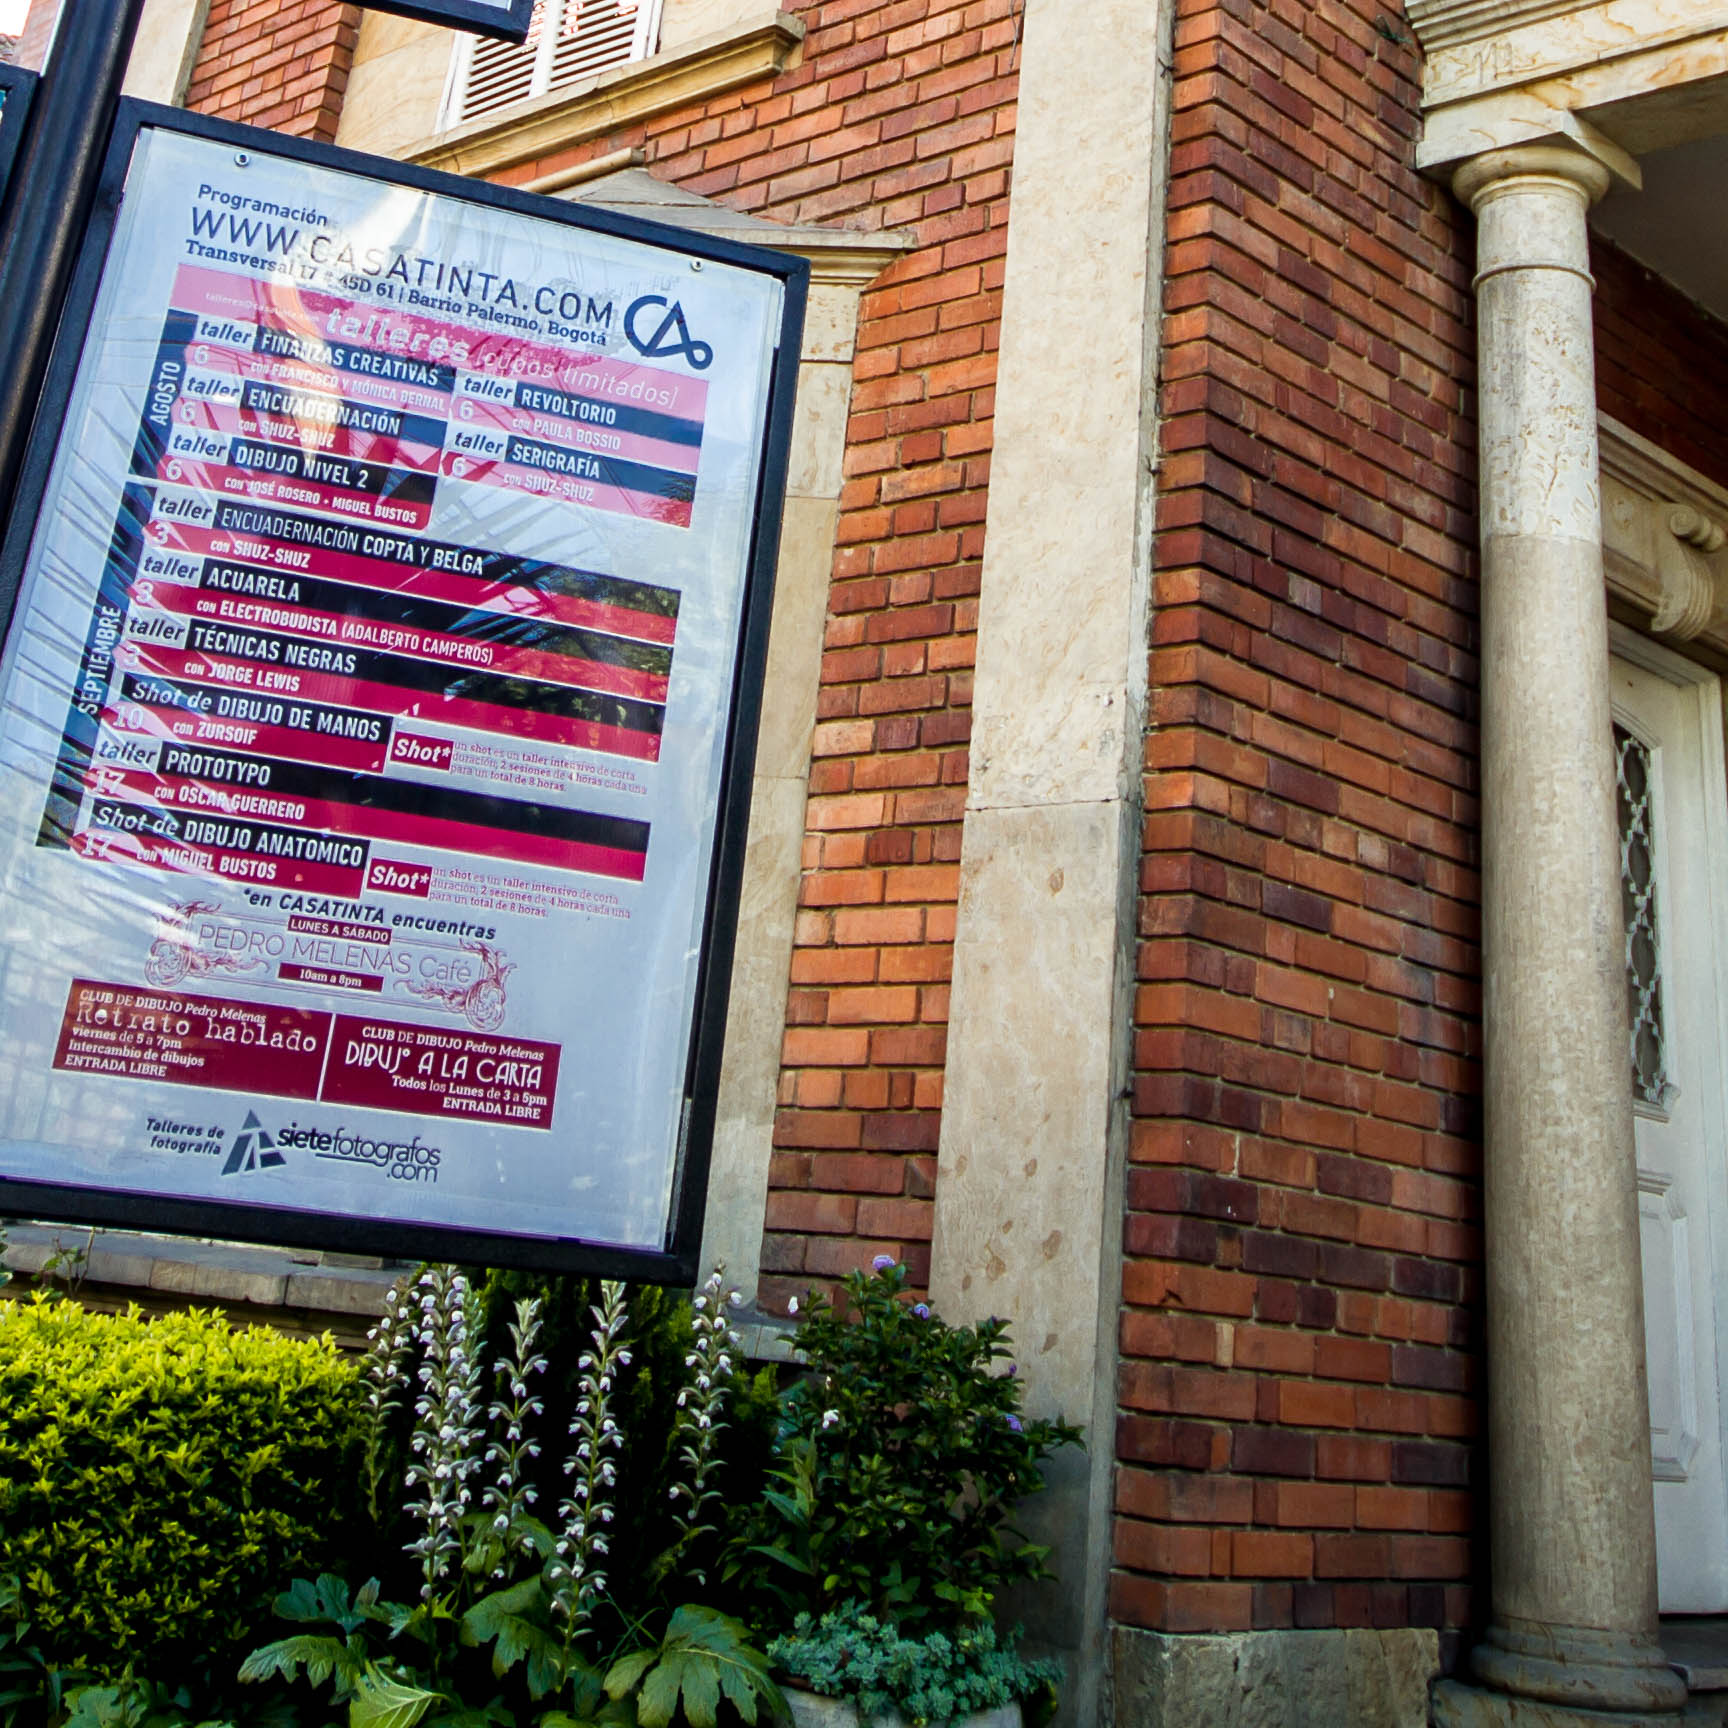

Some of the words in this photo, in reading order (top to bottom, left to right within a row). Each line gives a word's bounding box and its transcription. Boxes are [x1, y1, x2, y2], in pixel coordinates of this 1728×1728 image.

[198, 184, 327, 226] Programación
[192, 207, 613, 328] WWW.CASATINTA.COM
[186, 239, 293, 275] Transversal
[376, 282, 393, 298] 61
[408, 290, 461, 314] Barrio
[467, 303, 542, 333] Palermo,
[548, 321, 607, 346] Bogotá
[199, 320, 251, 345] taller
[261, 333, 343, 366] FINANZAS
[349, 352, 438, 386] CREATIVAS
[325, 308, 470, 361] talleres
[150, 362, 180, 426] AGOSTO
[187, 375, 240, 399] taller
[249, 388, 400, 435] ENCUADERNACIÓN
[272, 363, 338, 387] FRANCISCO
[351, 376, 396, 402] MÓNICA
[400, 389, 445, 411] BERNAL
[464, 376, 513, 400] taller
[522, 389, 616, 425] REVOLTORIO
[454, 431, 504, 455] taller
[512, 443, 600, 479] SERIGRAFÍA
[534, 419, 572, 441] PAULA
[576, 430, 621, 450] BOSSIO
[173, 433, 227, 457] taller
[236, 447, 298, 473] DIBUJO
[303, 459, 351, 485] NIVEL
[356, 471, 368, 488] 2
[247, 477, 275, 496] JOSÉ
[278, 486, 320, 504] ROSERO
[332, 496, 371, 516] MIGUEL
[374, 505, 417, 524] BUSTOS
[152, 524, 168, 544] 3
[233, 540, 311, 568] SHUZ-SHUZ
[158, 496, 212, 520] taller
[223, 508, 358, 552] ENCUADERNACIÓN
[420, 544, 429, 565] Y
[434, 549, 483, 575] BELGA
[145, 556, 199, 579] taller
[207, 568, 300, 601] ACUARELA
[128, 616, 185, 640] taller
[194, 627, 279, 660] TÉCNICAS
[284, 646, 356, 673] NEGRAS
[220, 600, 338, 635] ELECTROBUDISTA
[341, 622, 420, 651] (ADALBERTO
[422, 637, 493, 665] CAMPEROS)
[78, 606, 121, 715] SEPTIEMBRE
[208, 663, 252, 683] JORGE
[256, 672, 300, 691] LEWIS
[132, 681, 182, 707] Shot
[187, 692, 212, 710] de
[217, 696, 283, 724] DIBUJO
[289, 708, 310, 729] DE
[317, 713, 381, 741] MANOS
[197, 721, 257, 744] ZURSOIF
[99, 739, 156, 764] taller
[166, 750, 271, 785] PROTOTYPO
[231, 794, 305, 820] GUERRERO
[97, 807, 148, 833] Shot
[153, 816, 178, 835] de
[184, 821, 250, 849] DIBUJO
[256, 832, 362, 866] ANATOMICO
[161, 849, 214, 871] MIGUEL
[219, 856, 276, 879] BUSTOS
[279, 894, 384, 923] CASATINTA
[392, 912, 496, 940] encuentras
[291, 919, 328, 933] LUNES
[341, 926, 389, 943] SÁBADO
[198, 924, 284, 955] PEDRO
[292, 938, 410, 975] MELENAS
[419, 956, 471, 983] Café
[299, 968, 326, 983] 10am
[339, 975, 362, 989] 8pm
[77, 1003, 189, 1036] Retrato
[206, 1018, 317, 1052] hablado
[80, 989, 113, 1003] CLUB
[116, 995, 132, 1007] DE
[135, 996, 182, 1013] DIBUJO
[185, 1003, 217, 1019] Pedro
[220, 1008, 266, 1024] Melenas
[69, 1039, 141, 1059] Intercambio
[144, 1049, 158, 1061] de
[161, 1050, 204, 1068] dibujos
[72, 1025, 116, 1041] viernes
[119, 1031, 133, 1043] de
[156, 1036, 182, 1051] 7pm
[363, 1026, 395, 1041] CLUB
[398, 1032, 413, 1043] DE
[416, 1033, 462, 1050] DIBUJO
[465, 1040, 496, 1054] Pedro
[499, 1045, 544, 1061] Melenas
[65, 1054, 126, 1072] ENTRADA
[130, 1062, 167, 1077] LIBRE
[392, 1075, 426, 1090] Todos
[429, 1080, 446, 1092] los
[449, 1082, 483, 1097] Lunes
[487, 1088, 500, 1099] de
[418, 1051, 434, 1074] A
[441, 1054, 467, 1079] LA
[477, 1061, 541, 1089] CARTA
[146, 1118, 203, 1136] Talleres
[207, 1126, 224, 1139] de
[443, 1097, 502, 1115] ENTRADA
[505, 1104, 541, 1119] LIBRE
[150, 1135, 221, 1156] fotografía
[277, 1123, 440, 1166] sietefotografos
[386, 1163, 438, 1183] .com
